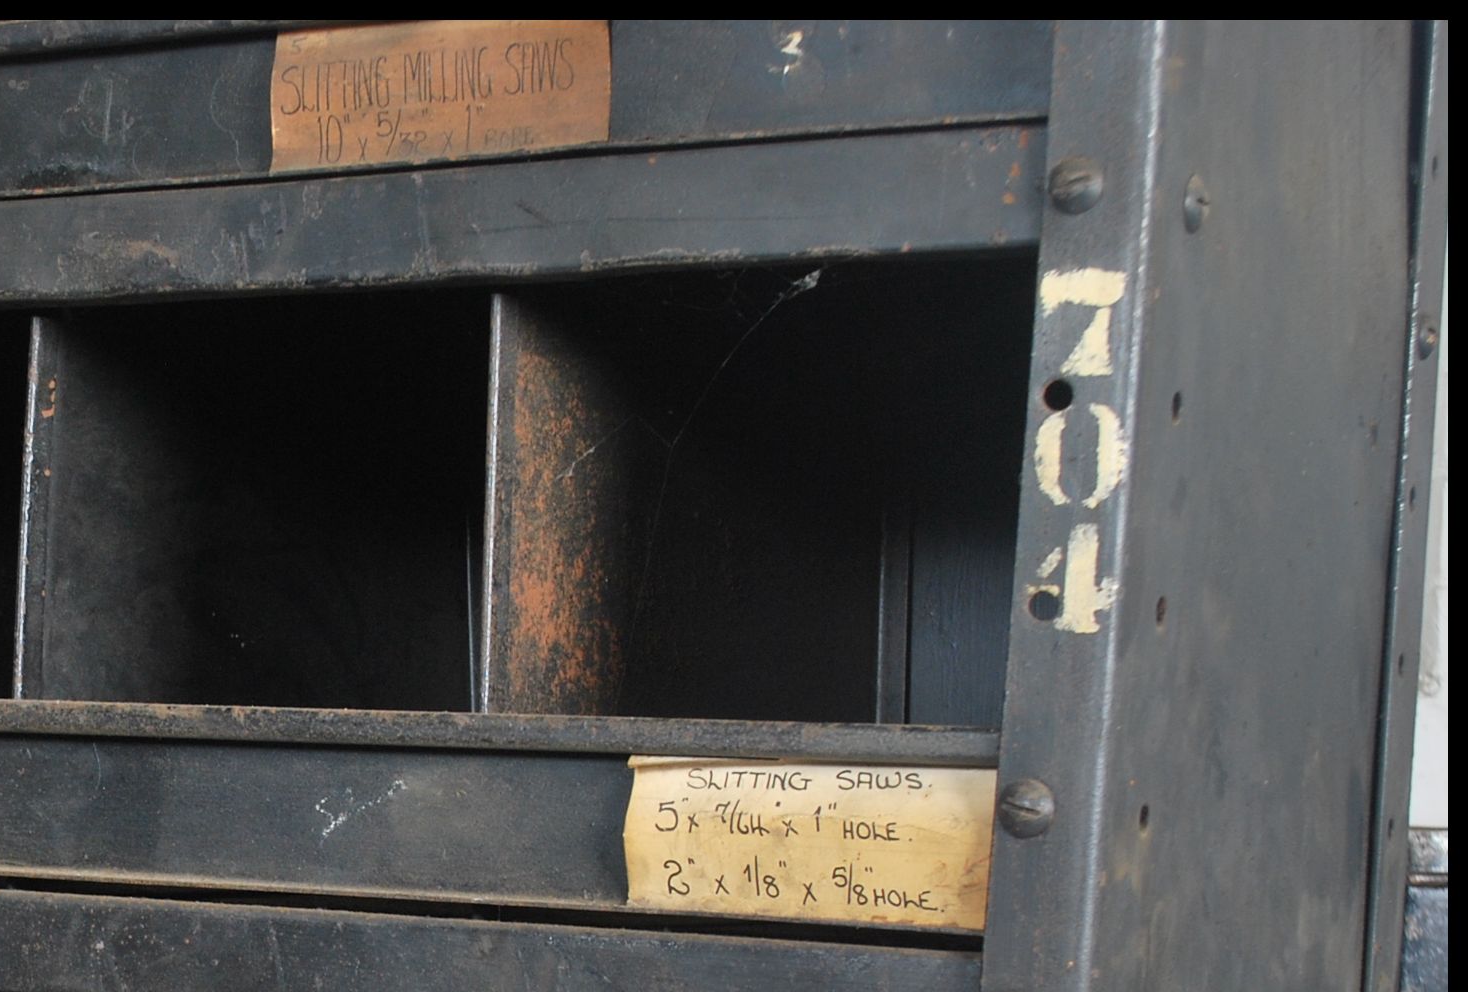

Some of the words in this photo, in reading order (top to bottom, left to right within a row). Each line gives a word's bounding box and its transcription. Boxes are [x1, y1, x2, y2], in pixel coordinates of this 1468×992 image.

[280, 56, 391, 116] SLITTING
[403, 45, 494, 105] MILLING
[503, 38, 575, 96] SAWS
[317, 113, 351, 164] 10"
[484, 125, 534, 149] BORE
[685, 767, 813, 792] SLITTING
[654, 796, 690, 834] 5"
[662, 856, 697, 897] 2"
[714, 872, 731, 897] x
[742, 854, 789, 898] 1/8"
[801, 880, 818, 907] x
